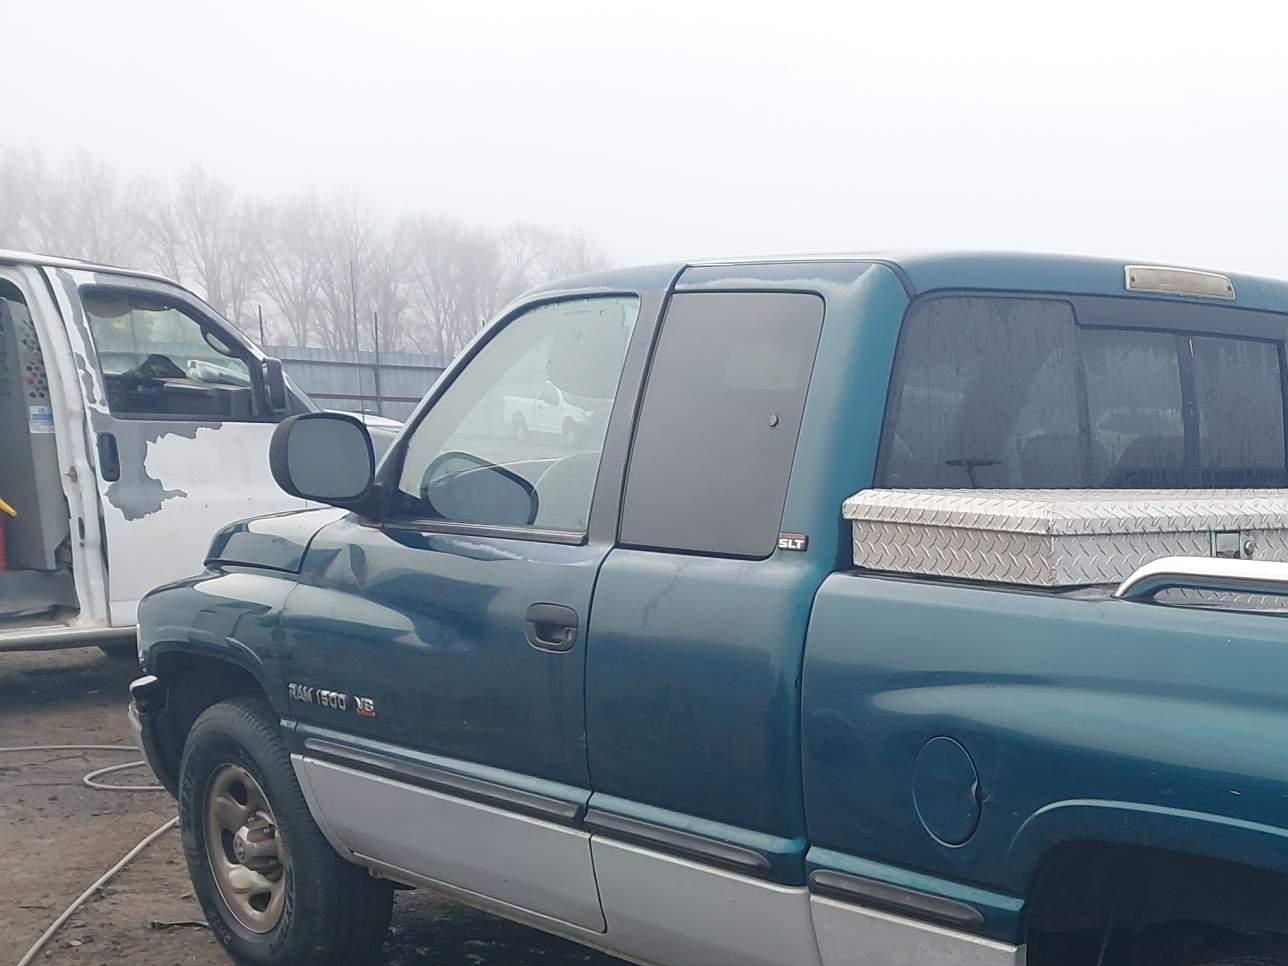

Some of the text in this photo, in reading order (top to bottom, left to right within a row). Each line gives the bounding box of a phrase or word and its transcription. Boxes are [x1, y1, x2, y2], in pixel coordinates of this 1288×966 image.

[778, 538, 805, 549] SLT
[288, 682, 313, 704] RAM
[315, 688, 347, 711] 1500
